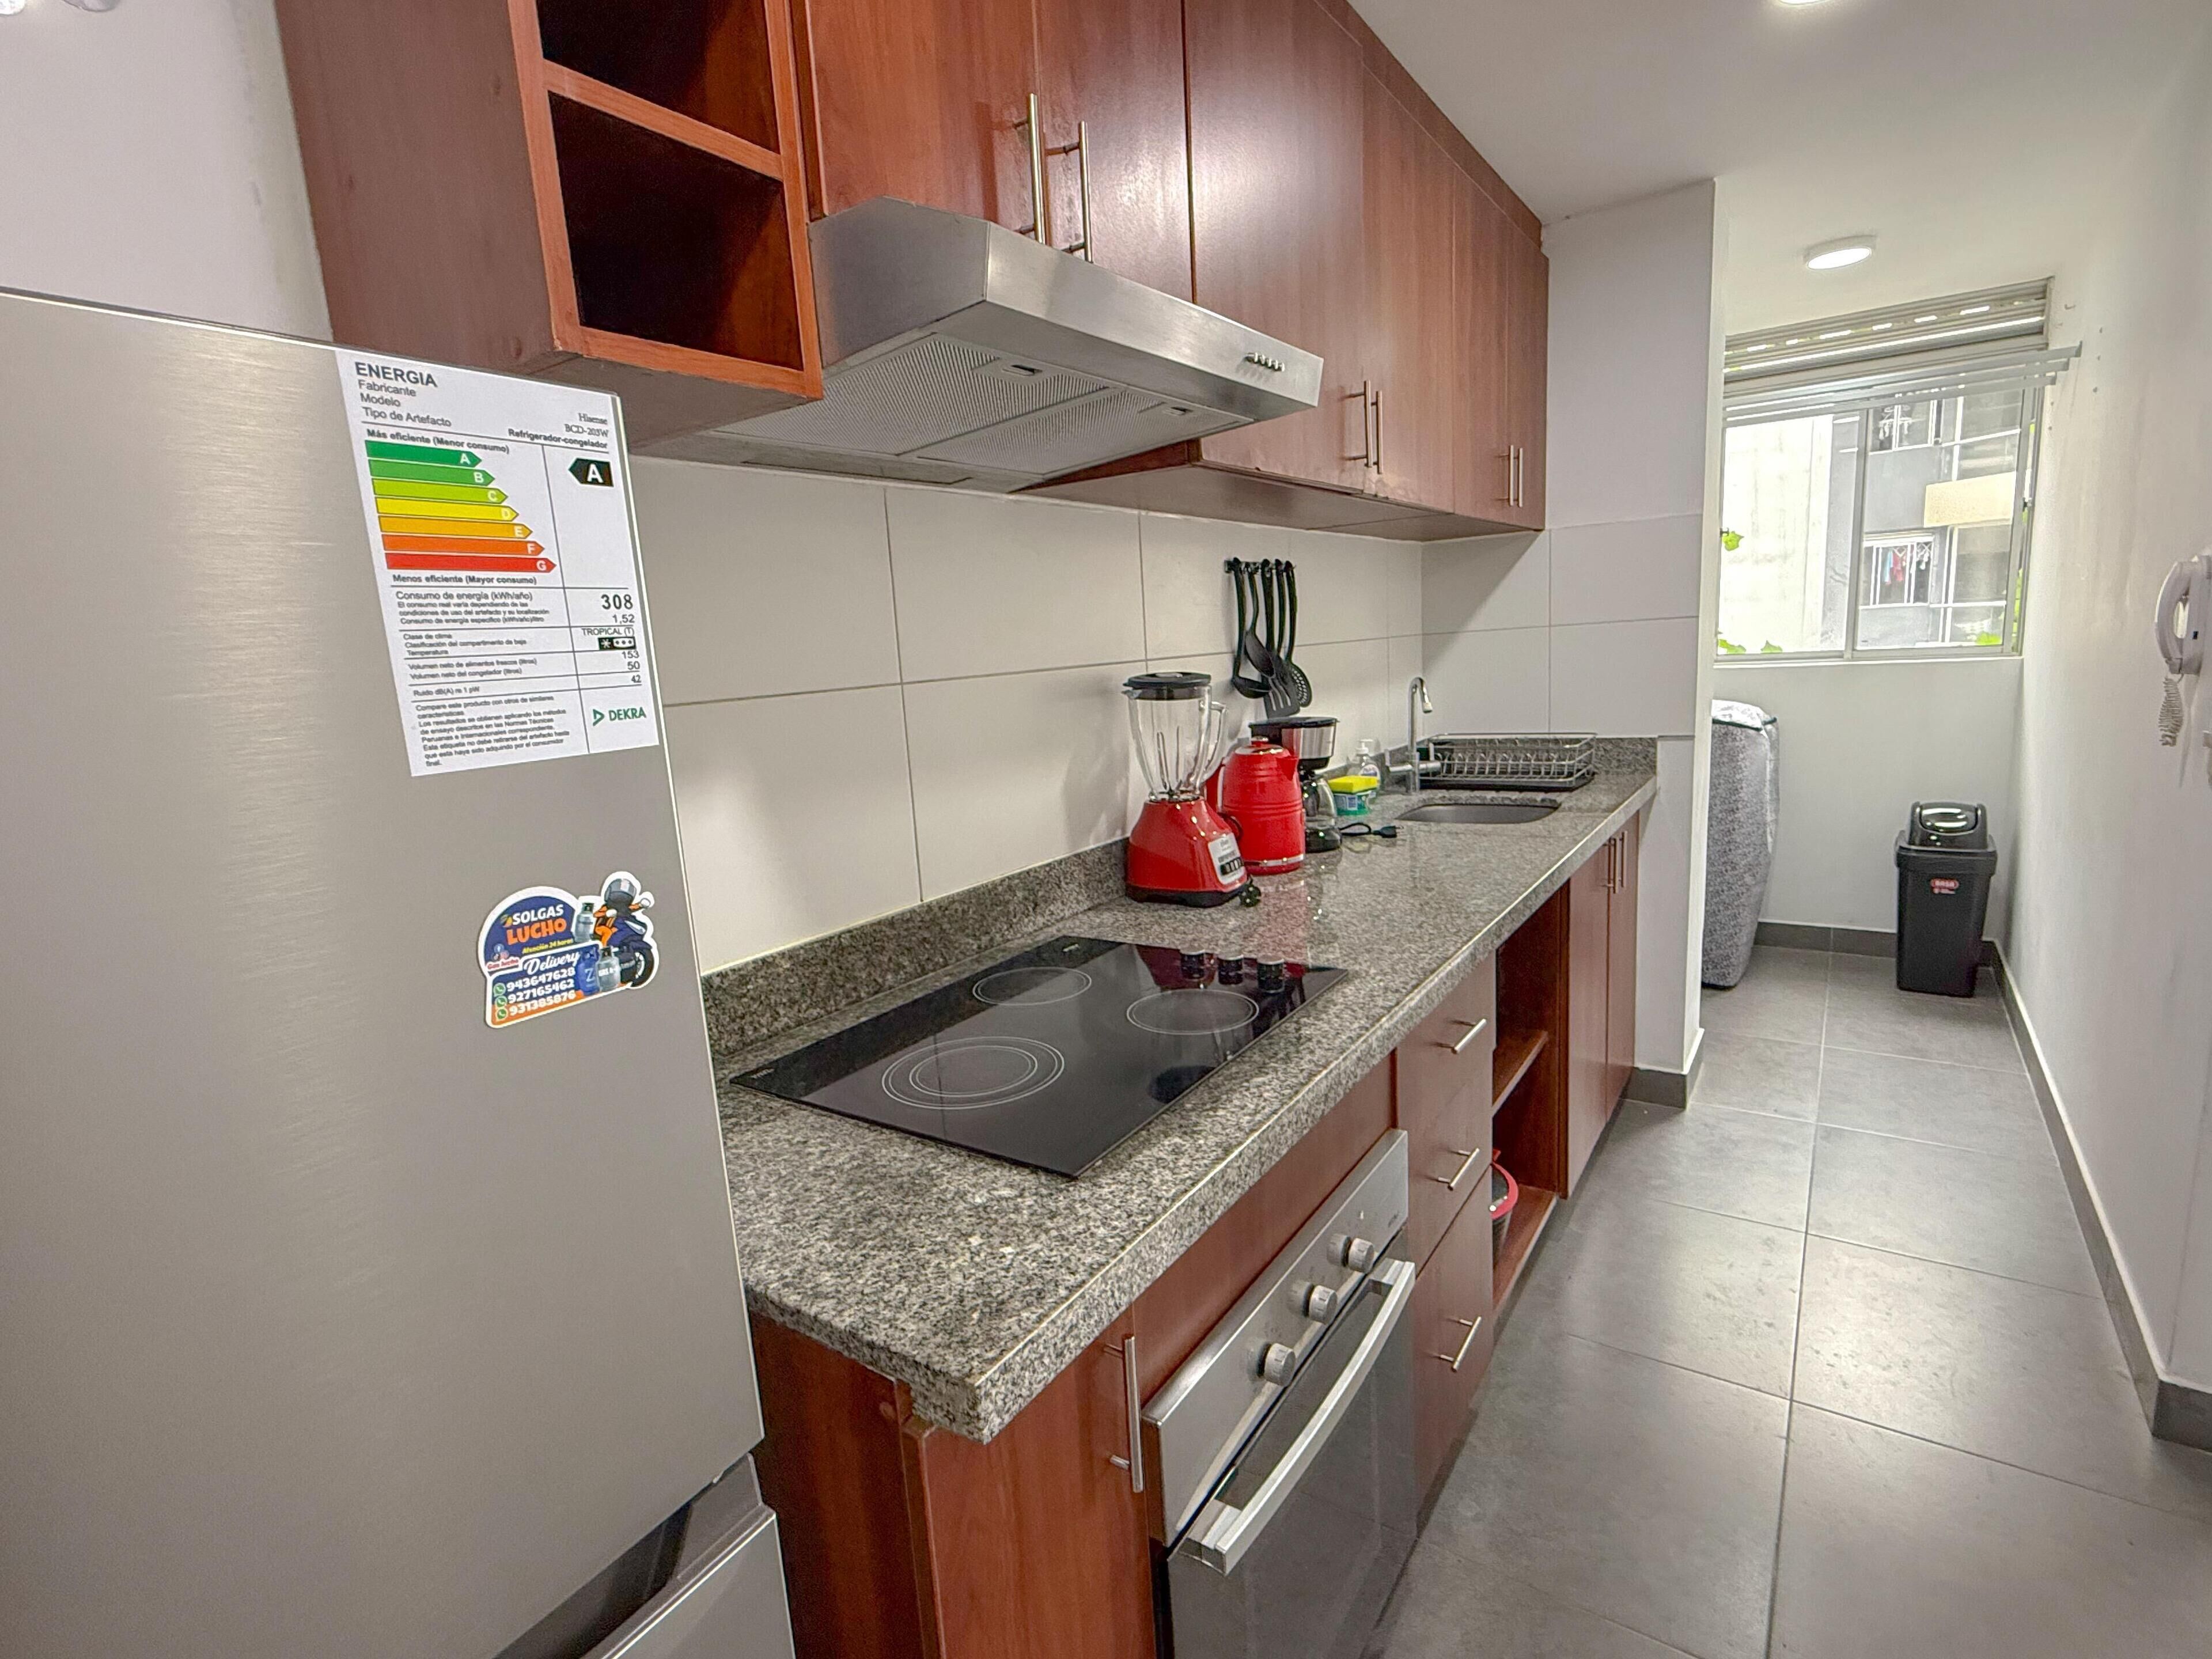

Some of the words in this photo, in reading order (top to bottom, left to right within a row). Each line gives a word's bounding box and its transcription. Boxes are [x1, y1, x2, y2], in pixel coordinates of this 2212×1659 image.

[355, 362, 438, 387] ENERGIA
[358, 380, 416, 397] Fabricante
[360, 393, 400, 407] Modelo
[362, 407, 387, 419] Tipo
[390, 411, 403, 421] de
[406, 412, 452, 426] Artefacto
[578, 413, 607, 425] Hisense
[366, 429, 387, 438] Más
[390, 431, 430, 444] eficiente
[433, 437, 464, 449] (Menor
[467, 442, 509, 454] consumo)
[508, 429, 607, 448] Refrigerador-congelador
[460, 453, 471, 465] A
[474, 472, 484, 483] B
[587, 464, 603, 483] A
[488, 491, 498, 501] C
[501, 509, 510, 518] D
[514, 527, 523, 537] E
[527, 544, 535, 554] F
[536, 560, 546, 570] G
[393, 574, 422, 582] Menos
[465, 575, 494, 585] (Mayor
[396, 591, 440, 600] Consumo
[456, 592, 488, 601] energía
[491, 592, 532, 601] (kWh/año)
[601, 594, 632, 609] 308
[613, 614, 634, 624] 1,52
[624, 627, 634, 637] (T)
[622, 651, 639, 659] 153
[628, 661, 639, 671] 50
[631, 675, 641, 683] 42
[609, 707, 646, 721] DEKRA
[512, 904, 563, 925] SOLGAS
[507, 918, 567, 945] LUCHO
[523, 952, 580, 975] Delivery
[506, 967, 575, 991] 943647628
[584, 968, 596, 982] Z
[508, 979, 574, 1003] 927165462
[509, 990, 575, 1016] 931385876
